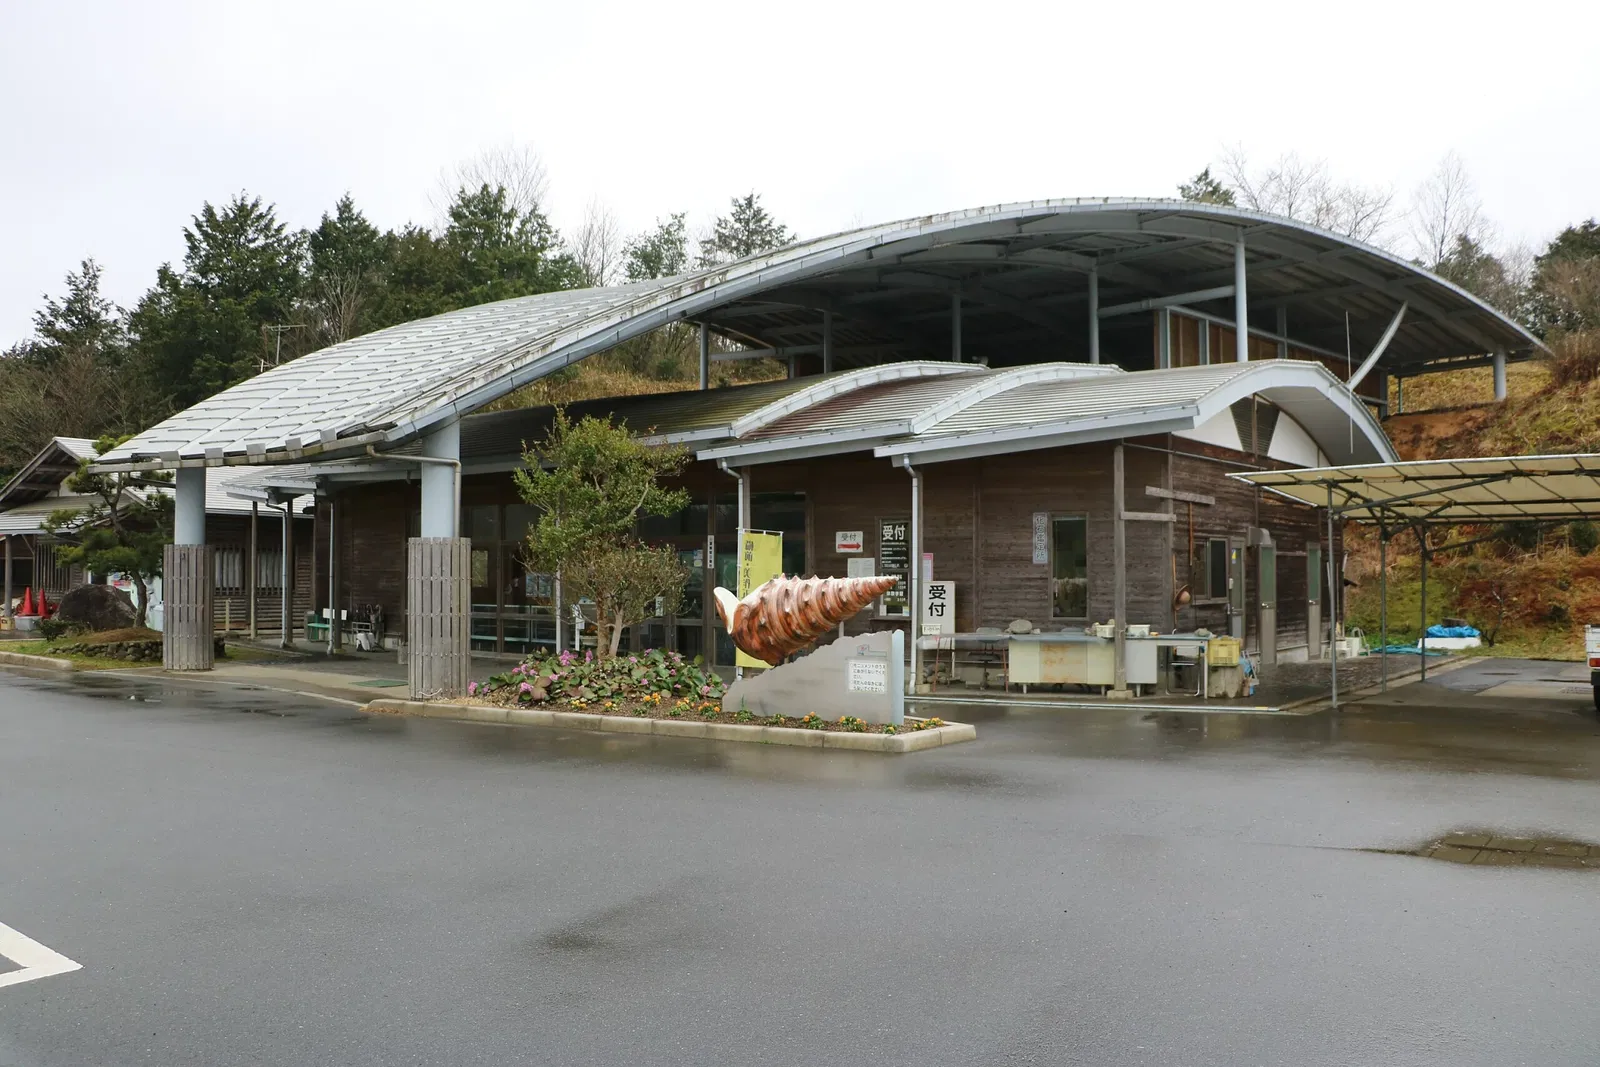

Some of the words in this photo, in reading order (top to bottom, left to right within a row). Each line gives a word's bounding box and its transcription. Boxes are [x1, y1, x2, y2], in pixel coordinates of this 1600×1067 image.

[841, 532, 857, 542] 受付
[881, 525, 906, 541] 受付
[928, 585, 947, 617] 受付
